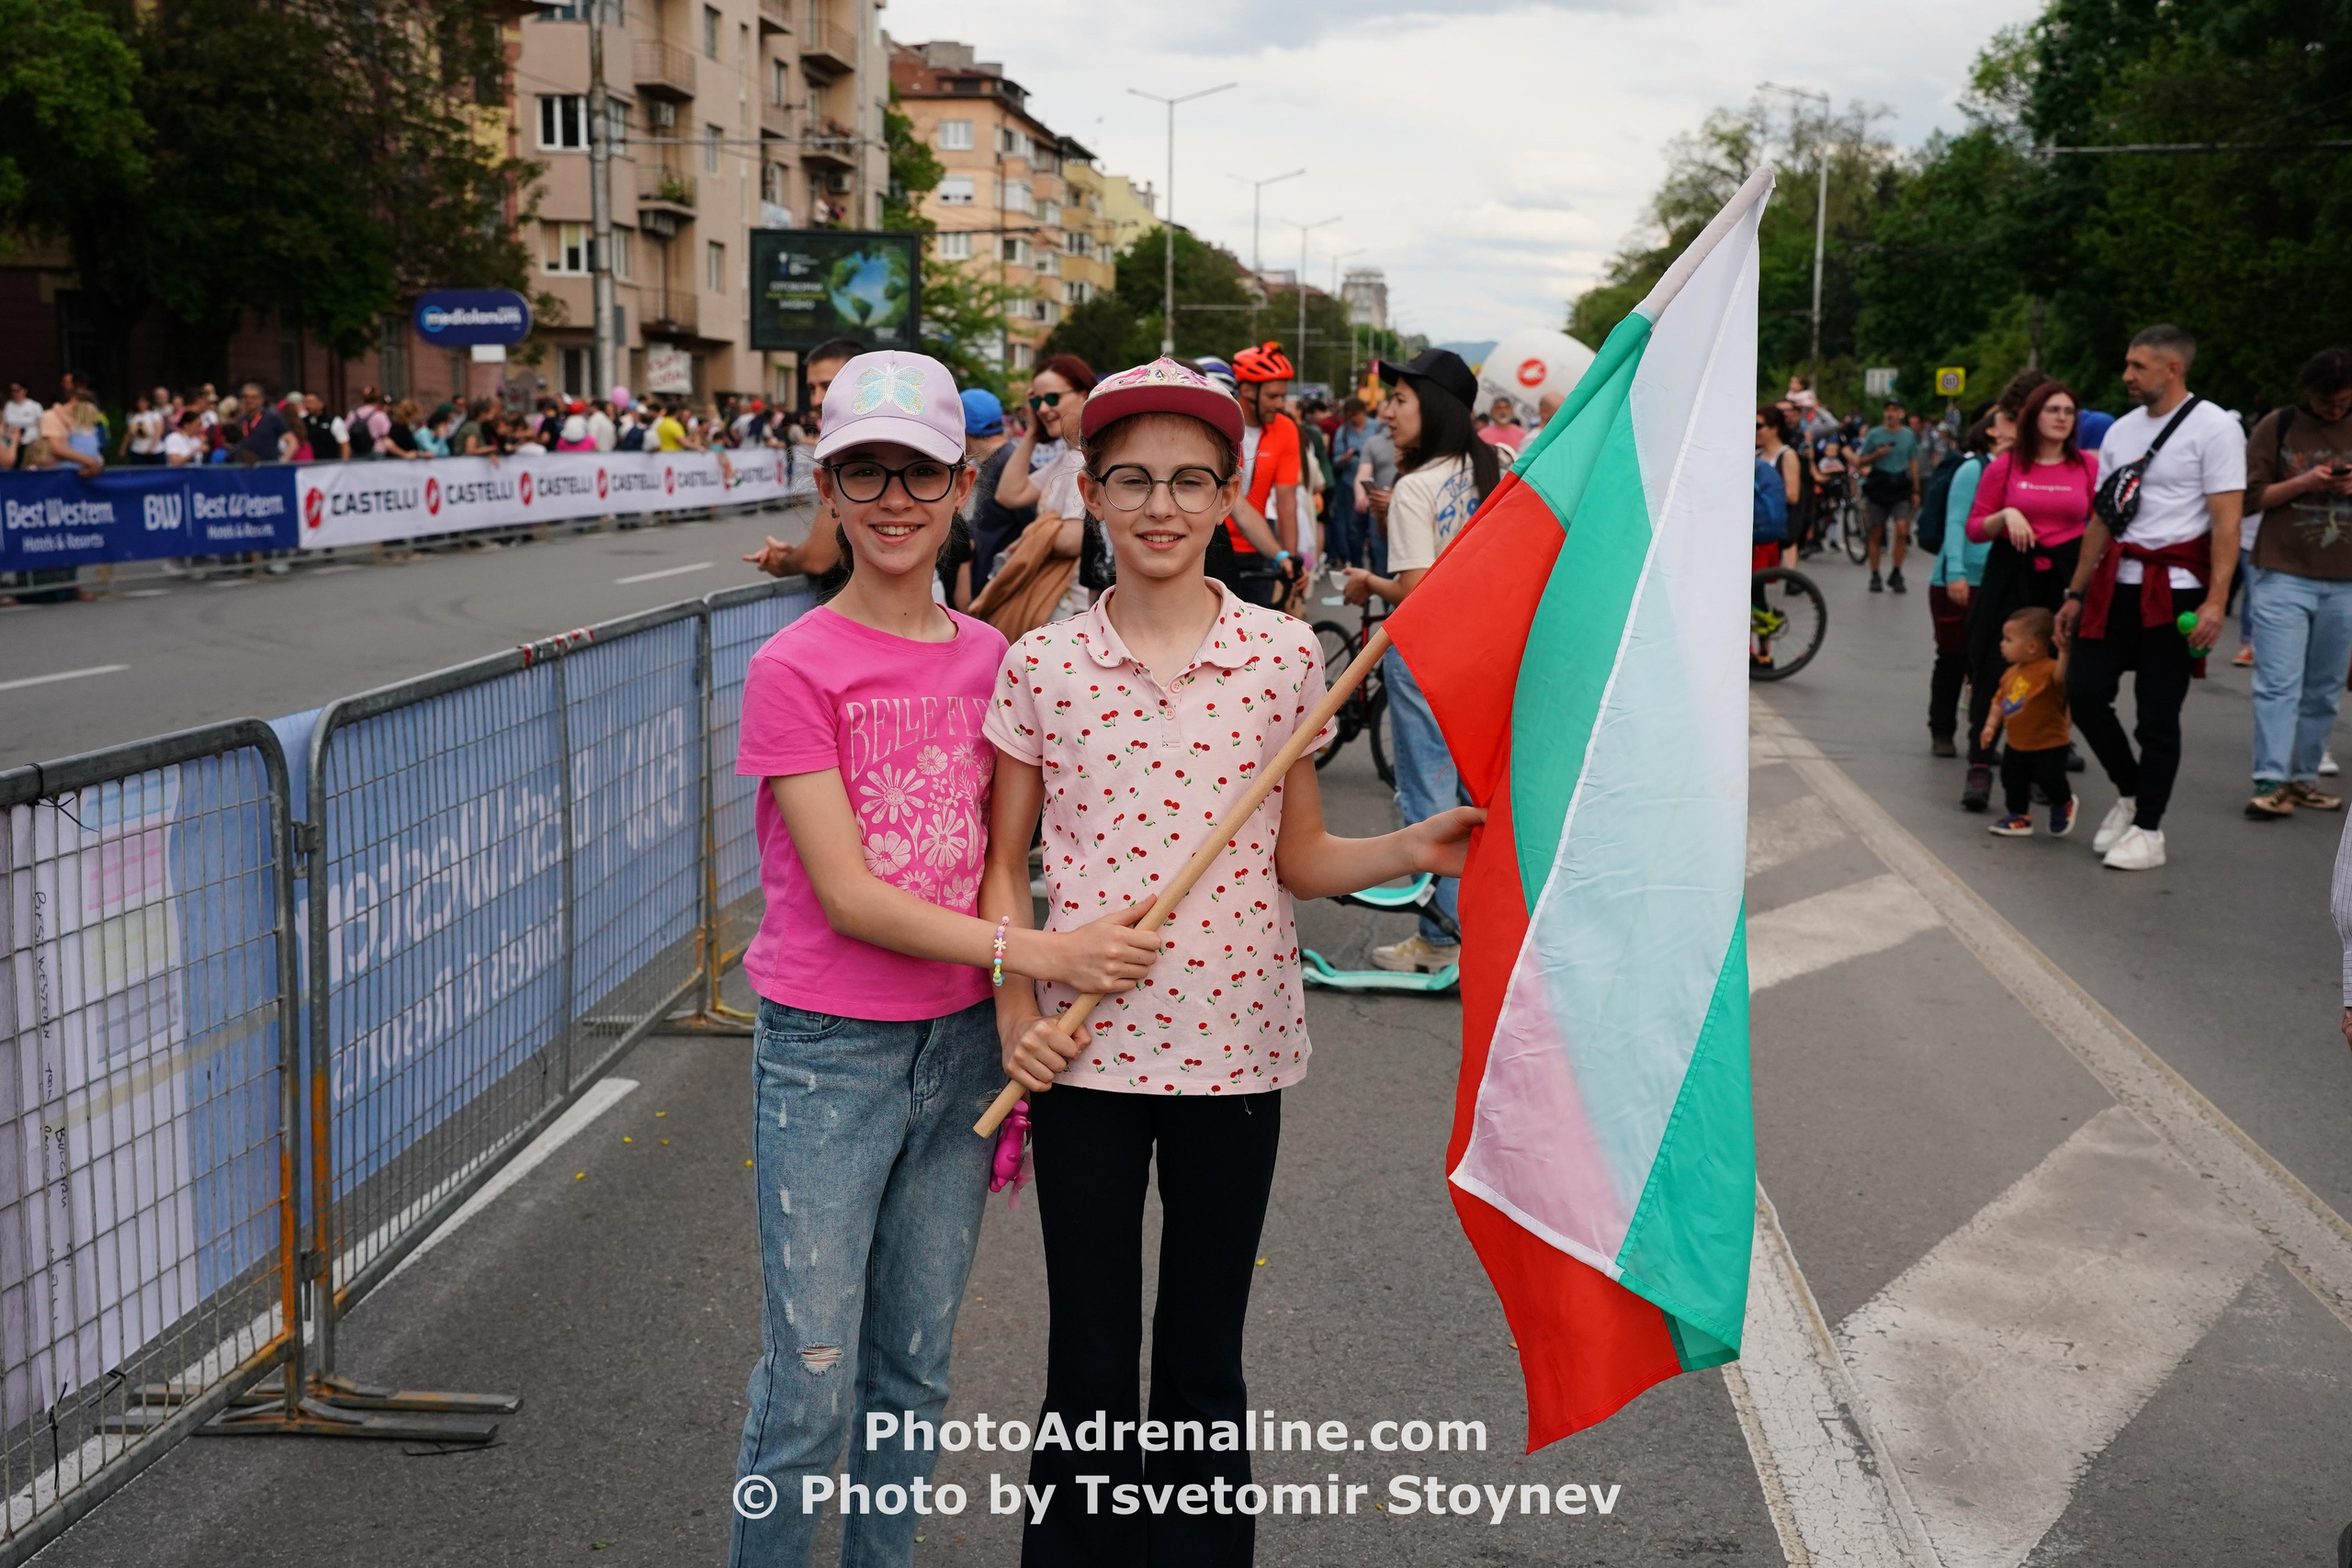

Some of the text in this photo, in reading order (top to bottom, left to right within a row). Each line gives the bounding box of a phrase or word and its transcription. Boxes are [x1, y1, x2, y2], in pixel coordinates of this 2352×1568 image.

[446, 479, 514, 505] CASTELLI
[537, 474, 594, 497] CASTELLI
[611, 471, 661, 492] CASTELLI
[5, 497, 115, 530] Best Western
[143, 493, 182, 531] BW
[193, 492, 227, 520] Best
[331, 487, 419, 516] CASTELLI
[22, 535, 55, 553] Hotels
[66, 532, 105, 550] Resorts
[845, 695, 992, 783] BELLE FLE
